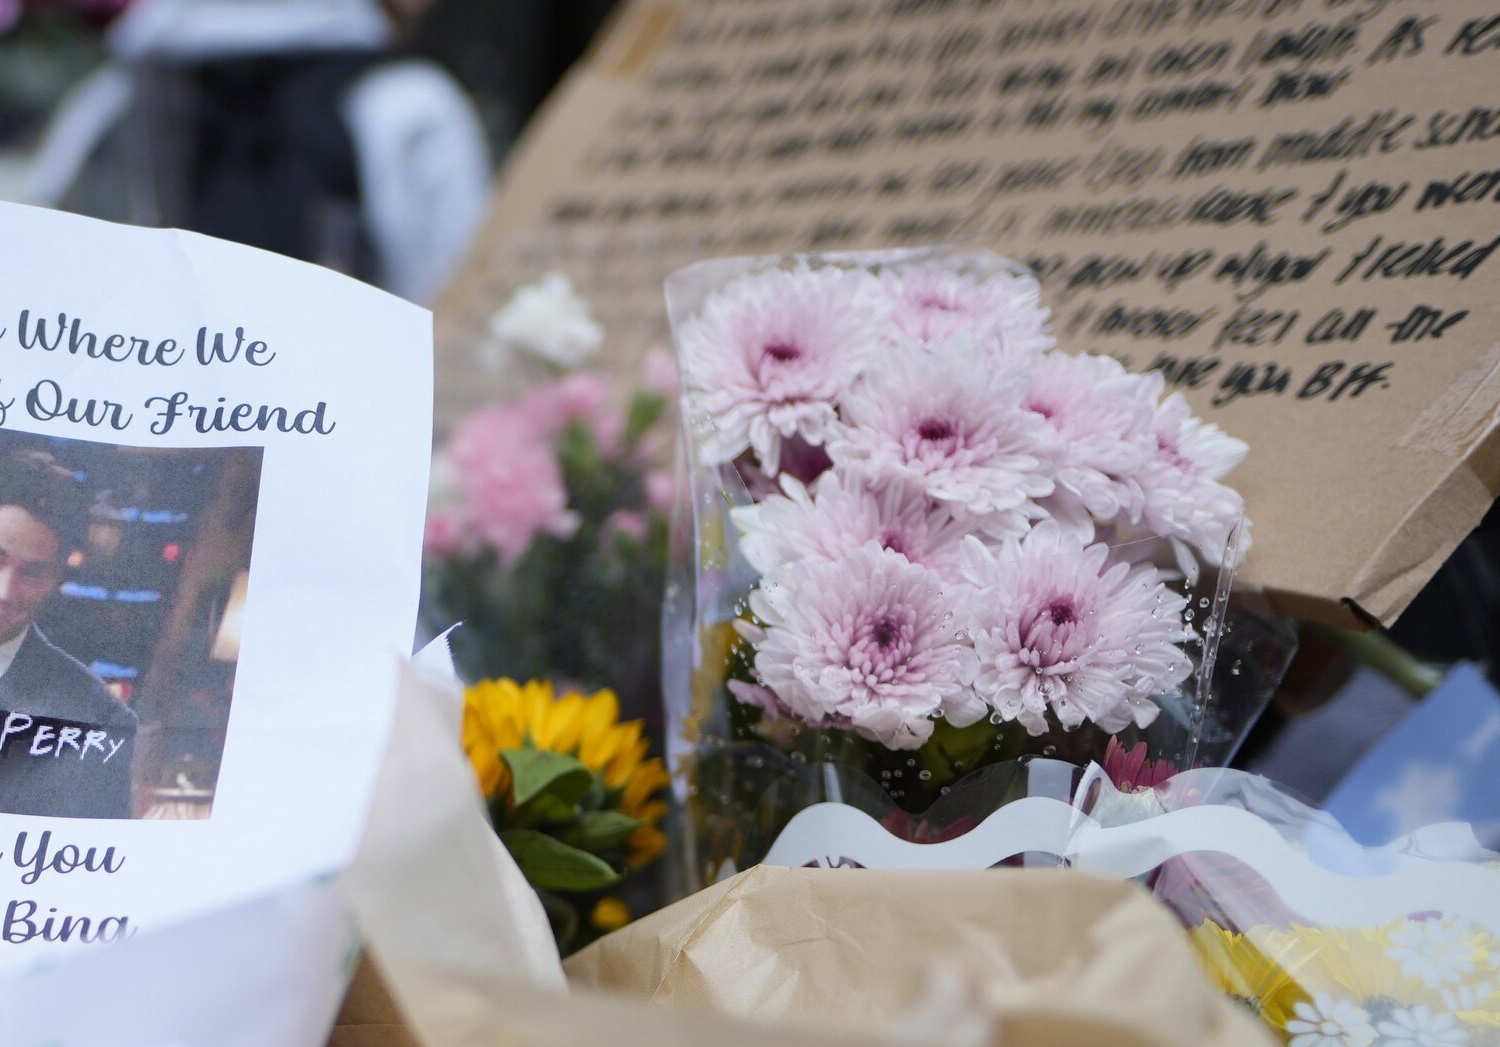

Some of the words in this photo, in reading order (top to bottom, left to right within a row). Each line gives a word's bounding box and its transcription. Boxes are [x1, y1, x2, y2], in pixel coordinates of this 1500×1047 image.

[1412, 106, 1500, 150] sch
[17, 309, 185, 367] Where
[195, 327, 276, 367] We
[26, 379, 133, 430] Our
[144, 391, 336, 435] Friend
[13, 830, 126, 885] You
